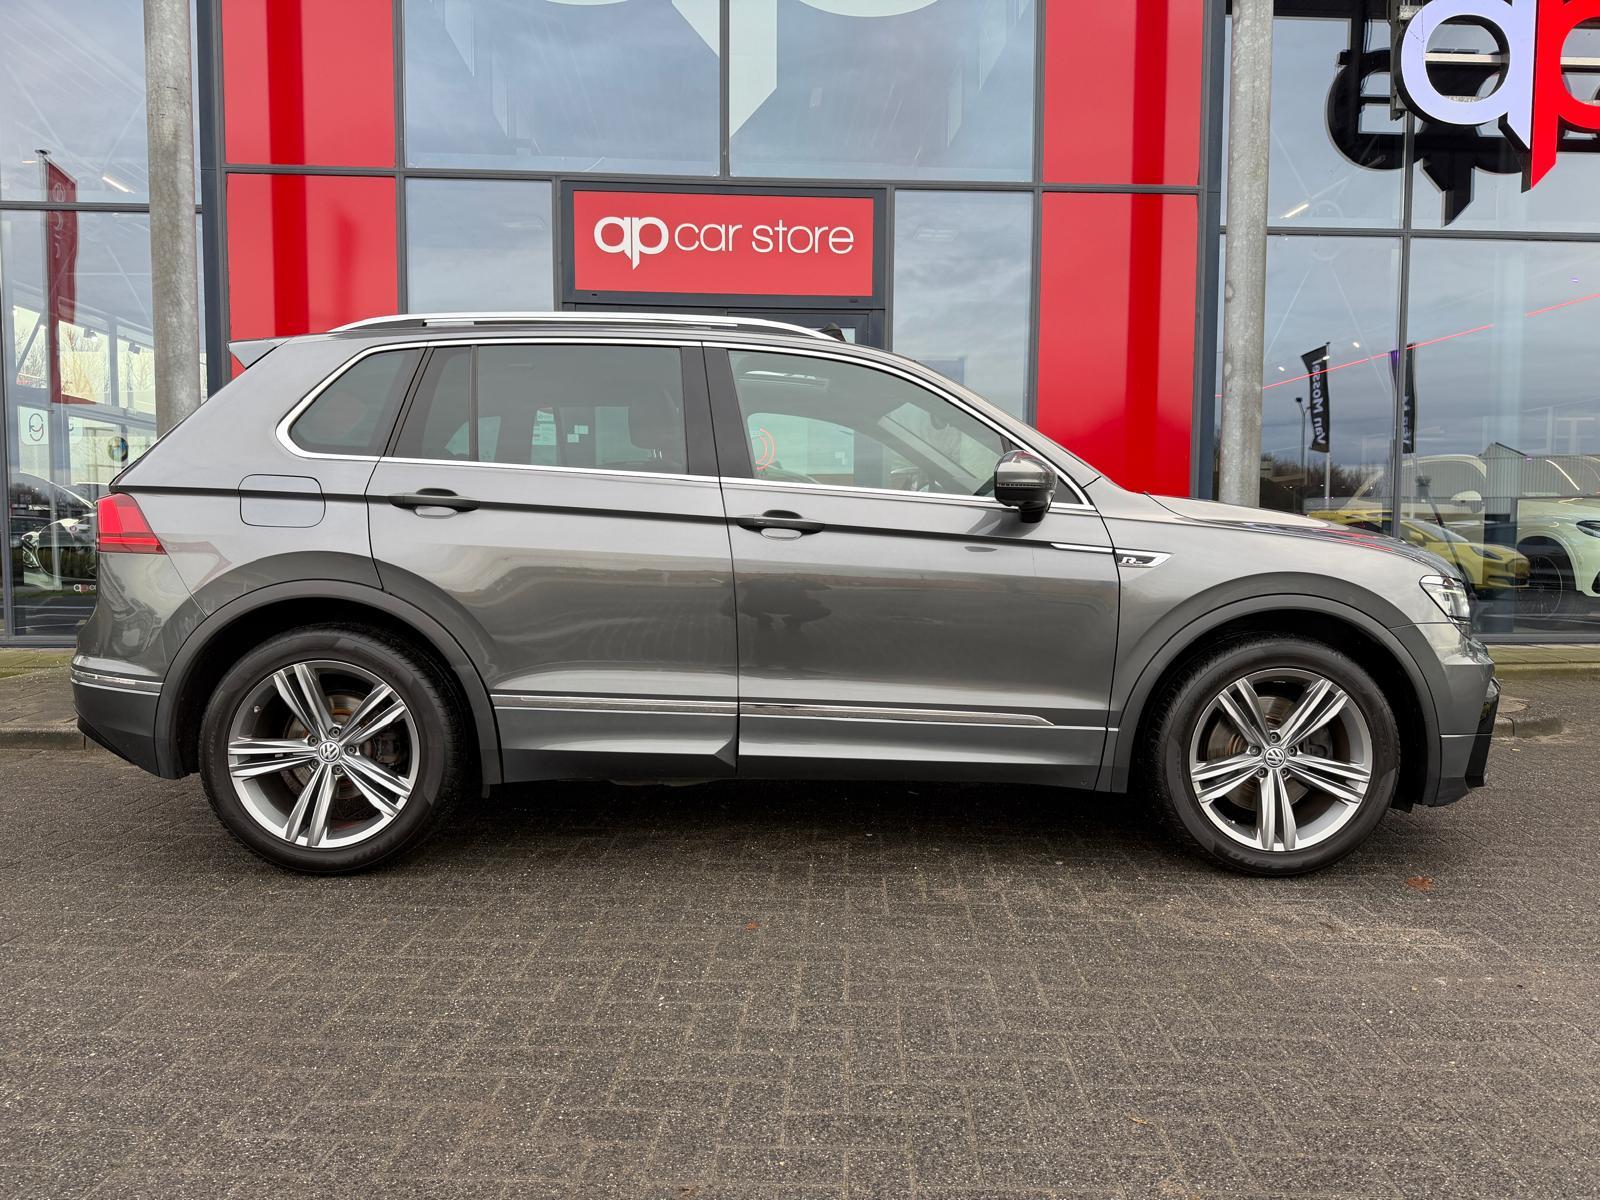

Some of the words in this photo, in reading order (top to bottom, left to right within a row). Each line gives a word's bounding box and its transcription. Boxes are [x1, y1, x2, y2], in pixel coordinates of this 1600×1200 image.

[593, 216, 669, 270] ap
[674, 223, 743, 251] car
[751, 219, 854, 254] store
